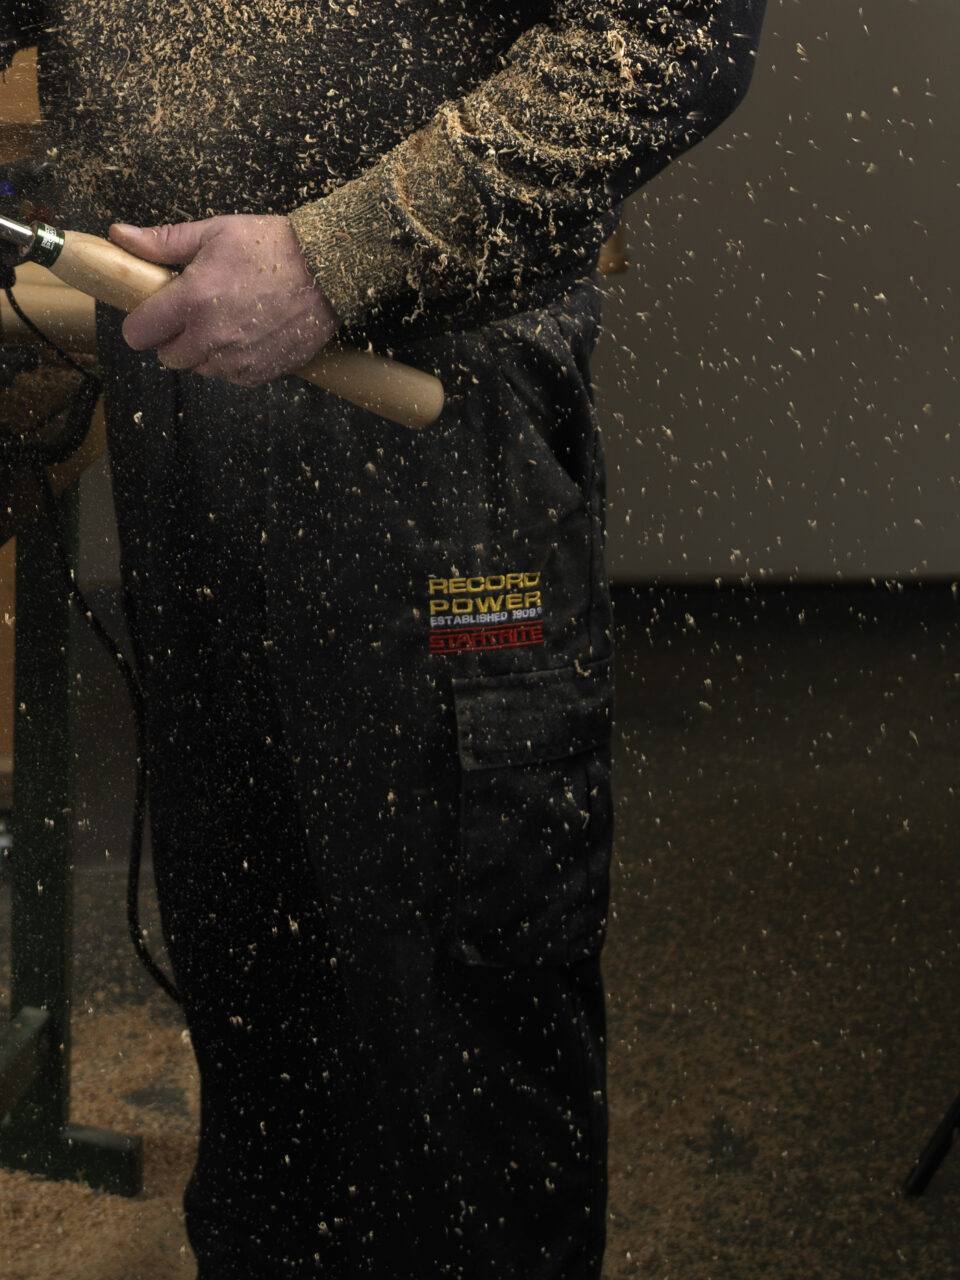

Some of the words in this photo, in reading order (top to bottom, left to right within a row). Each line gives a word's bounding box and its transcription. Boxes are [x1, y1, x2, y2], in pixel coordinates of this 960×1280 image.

[428, 572, 541, 595] RECORD
[429, 590, 542, 616] POWER
[429, 611, 508, 628] ESTABLISHED
[428, 625, 543, 650] STARTRITE
